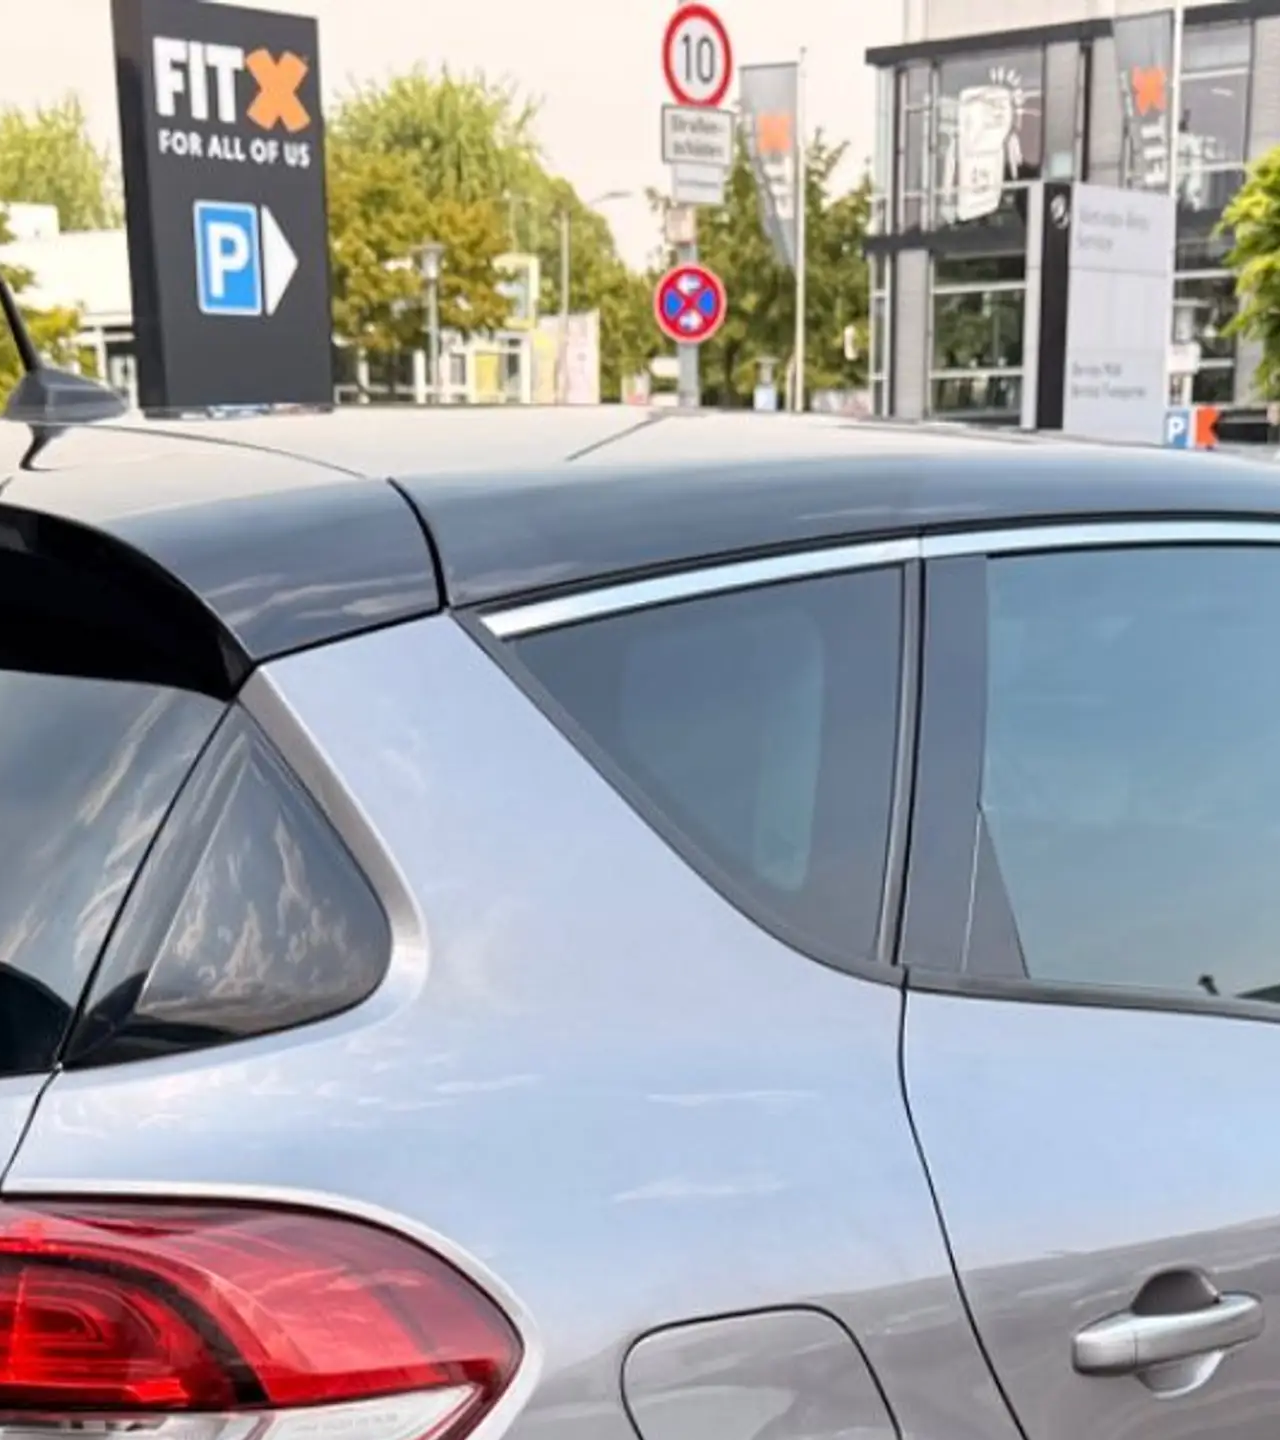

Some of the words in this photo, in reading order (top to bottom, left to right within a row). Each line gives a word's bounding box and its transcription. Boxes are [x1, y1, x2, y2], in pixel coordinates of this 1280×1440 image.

[153, 36, 311, 132] FITX
[682, 33, 715, 84] 10
[158, 128, 203, 157] FOR
[208, 134, 247, 162] ALL
[250, 137, 279, 164] OF
[283, 141, 311, 168] US
[207, 221, 249, 298] P
[1168, 416, 1185, 443] P
